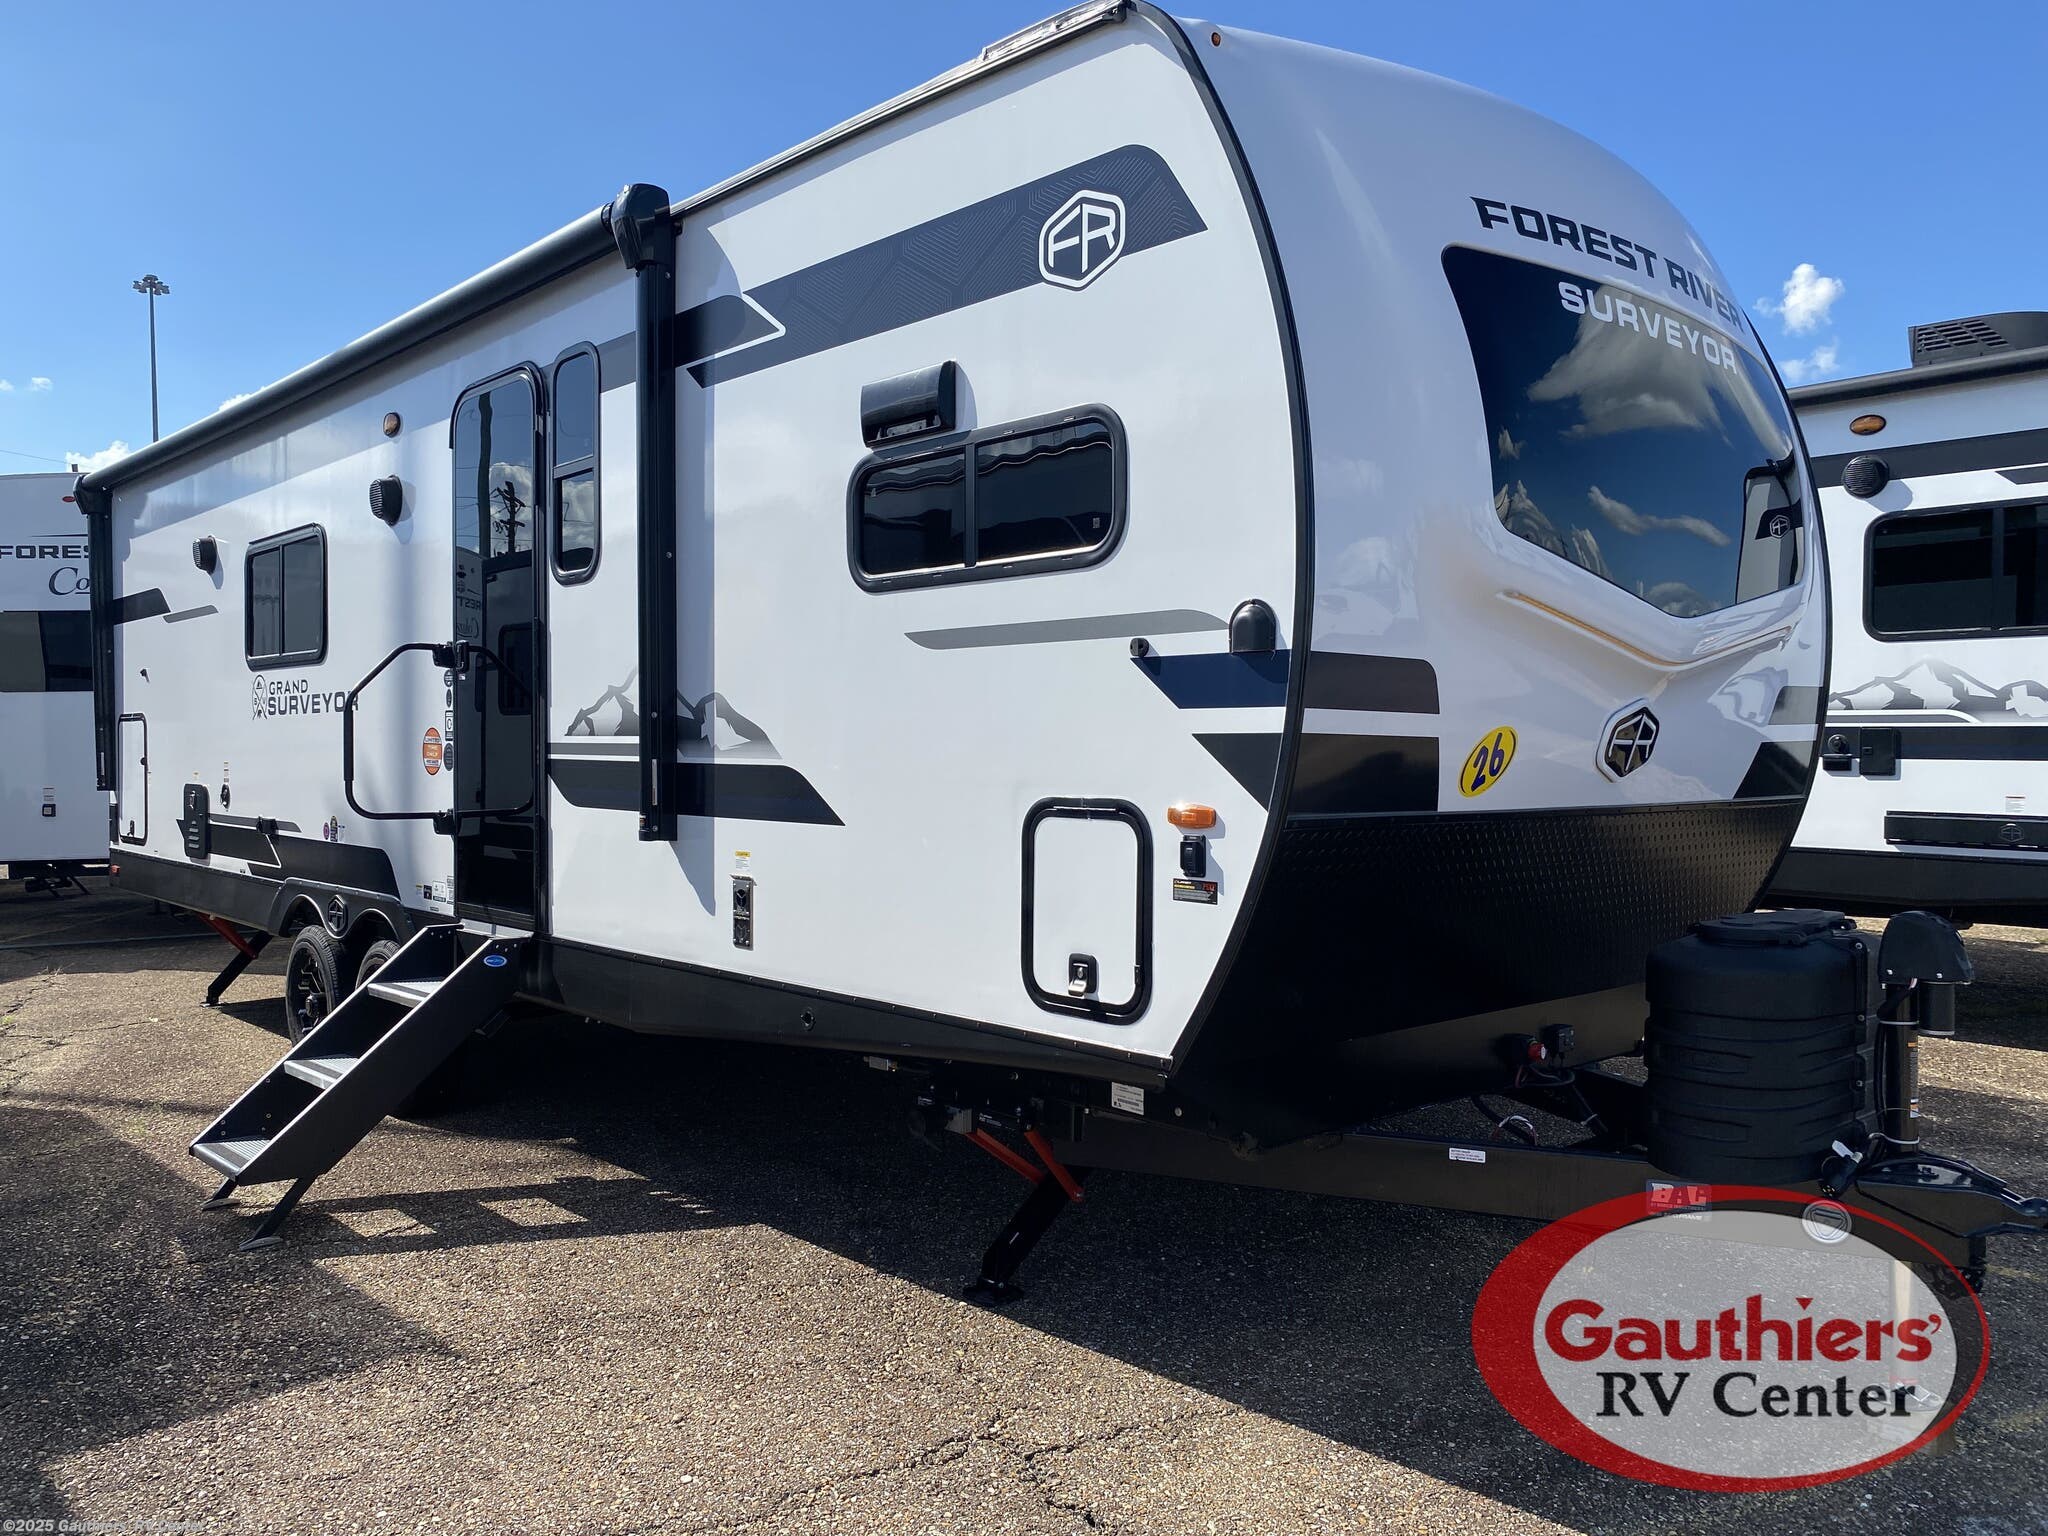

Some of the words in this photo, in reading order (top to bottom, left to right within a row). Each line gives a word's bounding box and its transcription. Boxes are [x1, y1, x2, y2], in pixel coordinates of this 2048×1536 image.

[1469, 195, 1658, 279] FOREST
[1663, 256, 1745, 334] RIVER
[1557, 281, 1738, 376] SURVEYOR
[0, 545, 89, 559] FORE
[269, 680, 308, 695] GRAND
[1470, 732, 1505, 793] 26
